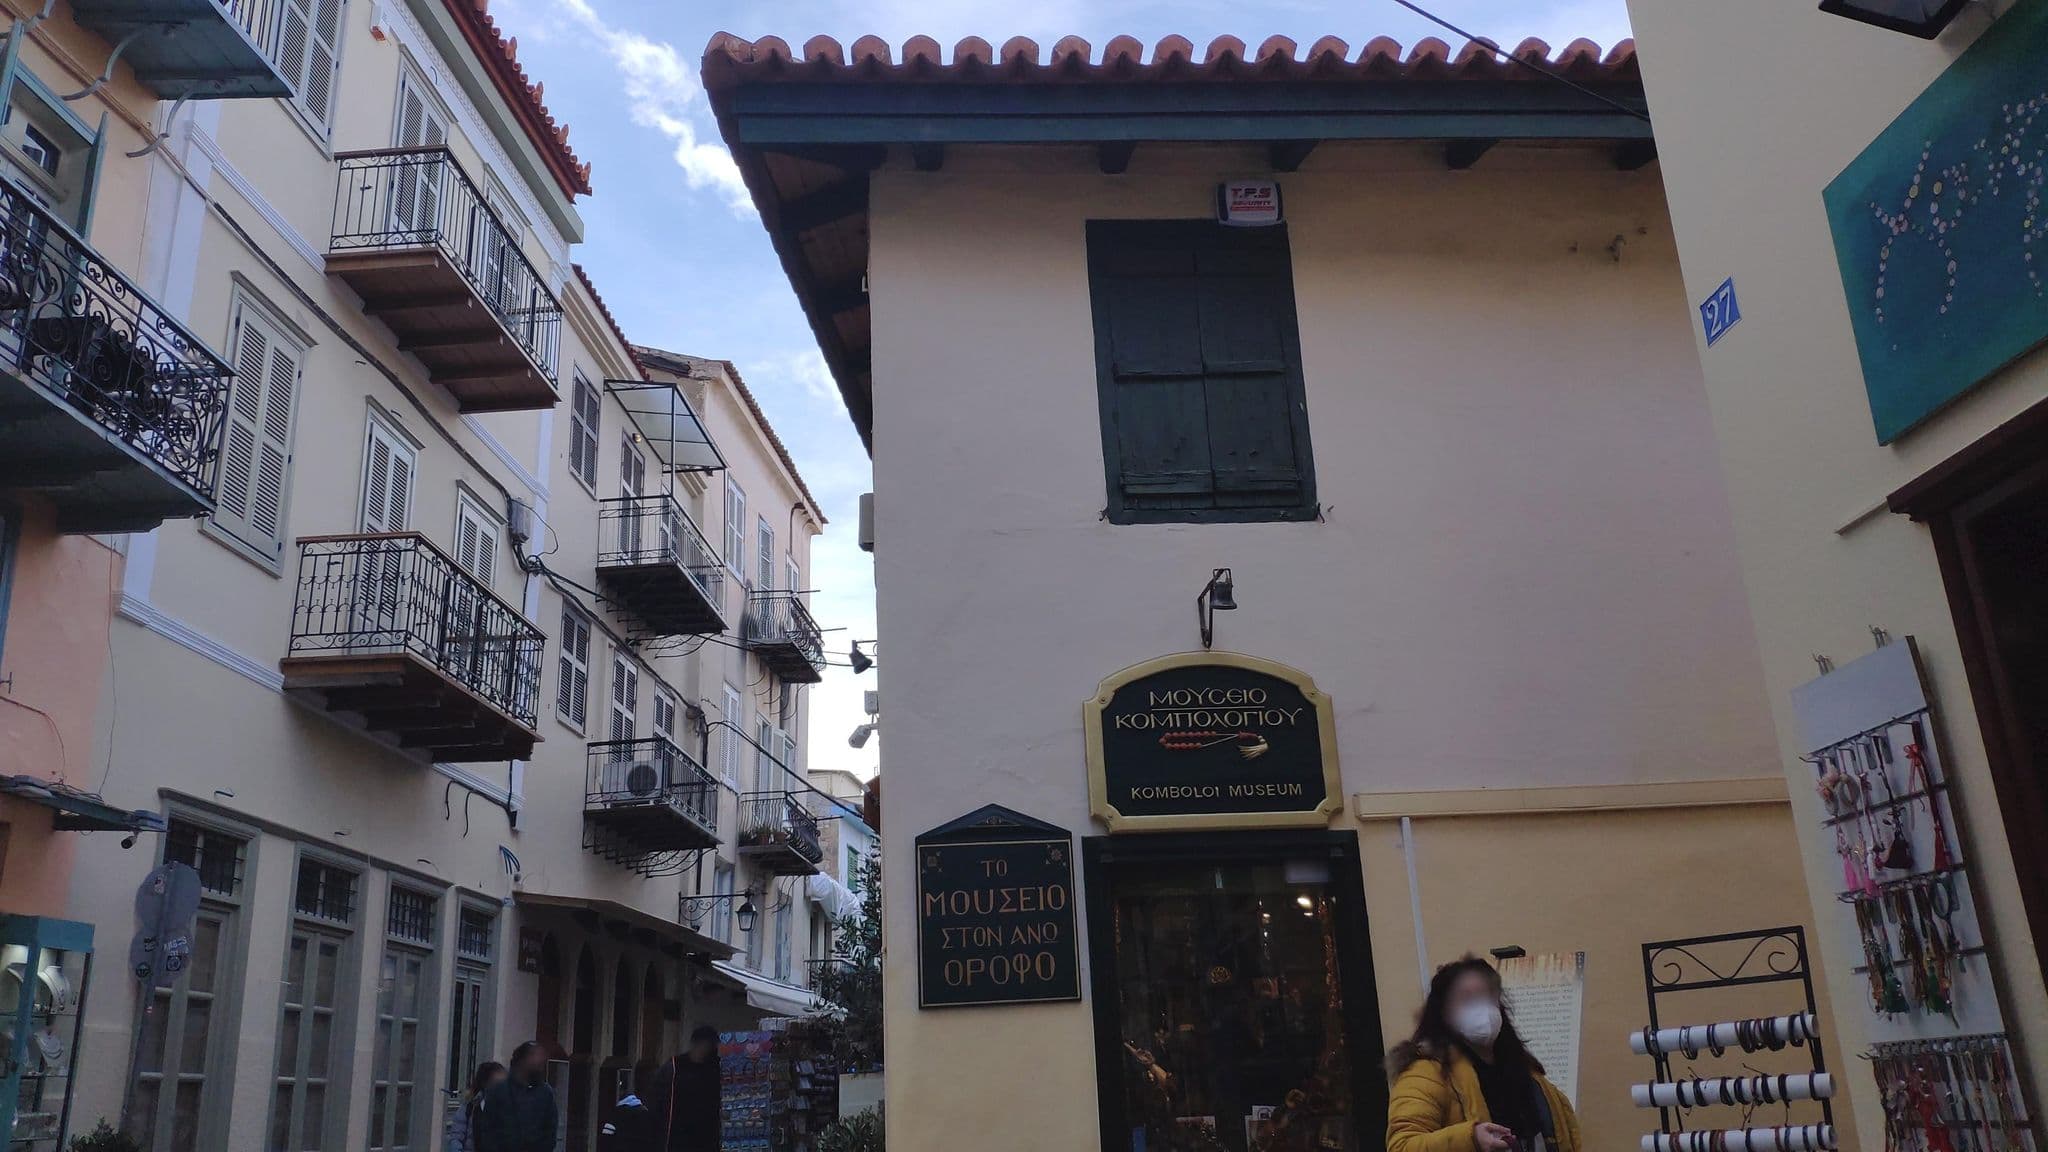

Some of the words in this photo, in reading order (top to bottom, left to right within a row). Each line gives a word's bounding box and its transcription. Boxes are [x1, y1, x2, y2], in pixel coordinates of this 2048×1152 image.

[1706, 285, 1730, 339] 27
[1131, 786, 1219, 800] KOMBOLOI
[1228, 783, 1303, 797] MUSEUM
[980, 859, 1008, 878] ΤΟ
[941, 926, 1003, 949] ΣΤΟΝ
[1010, 921, 1058, 945] ΑΝΩ
[943, 951, 1056, 986] ΟΡΟΦΟ
